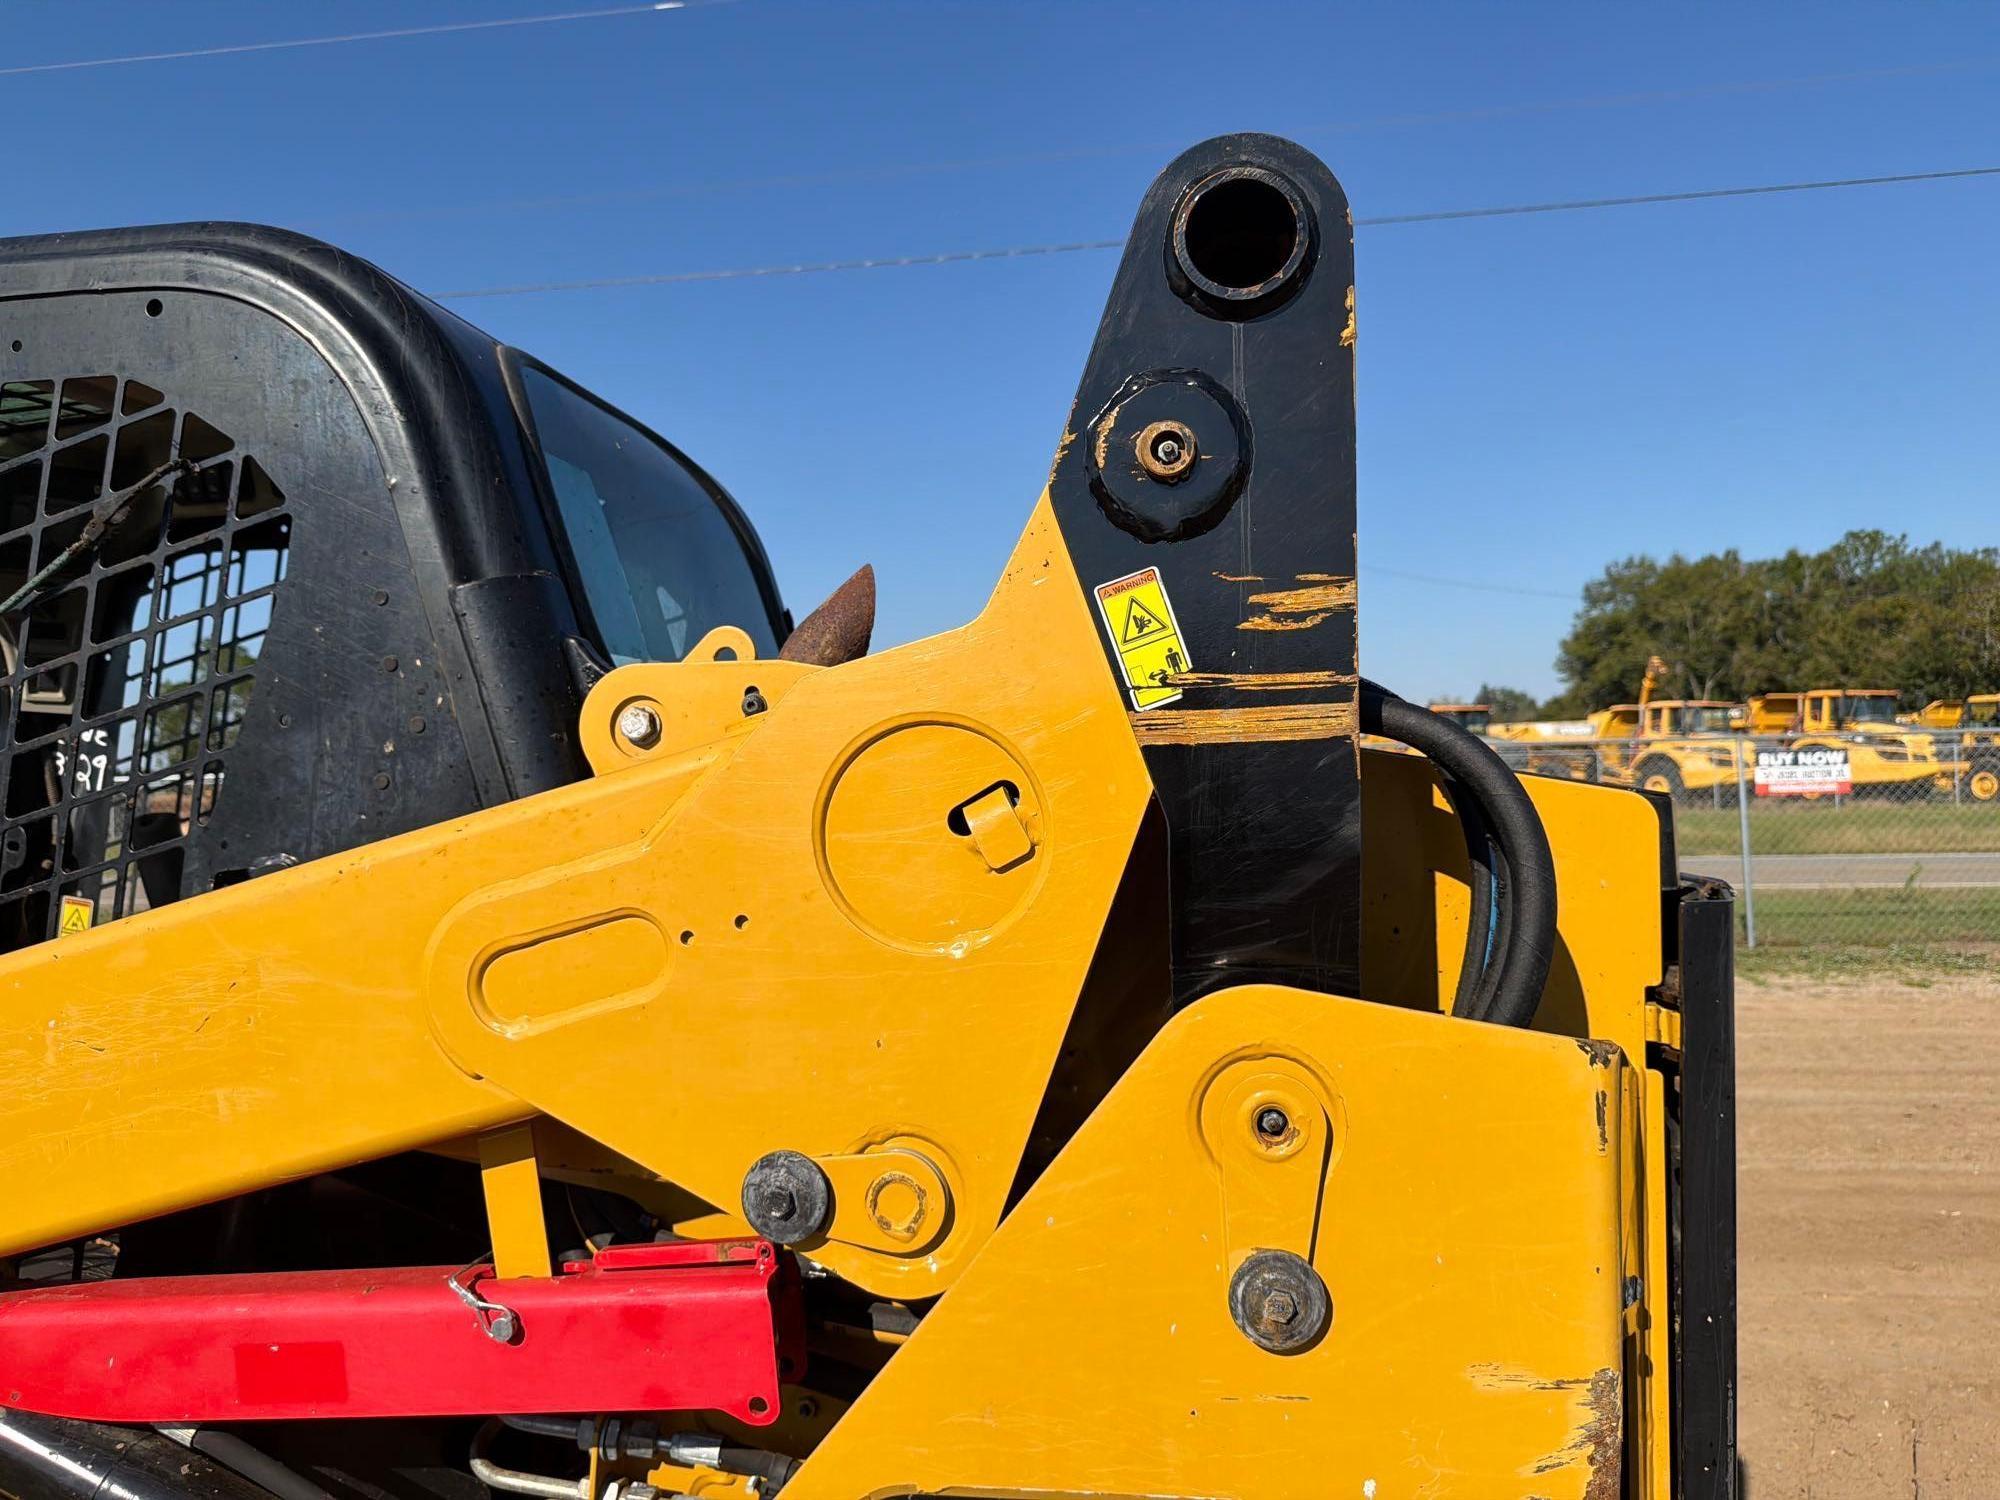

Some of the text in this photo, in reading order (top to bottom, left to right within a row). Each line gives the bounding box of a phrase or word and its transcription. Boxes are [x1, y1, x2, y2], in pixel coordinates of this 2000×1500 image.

[1112, 574, 1154, 595] WARNING
[1758, 750, 1846, 766] BUY NOW
